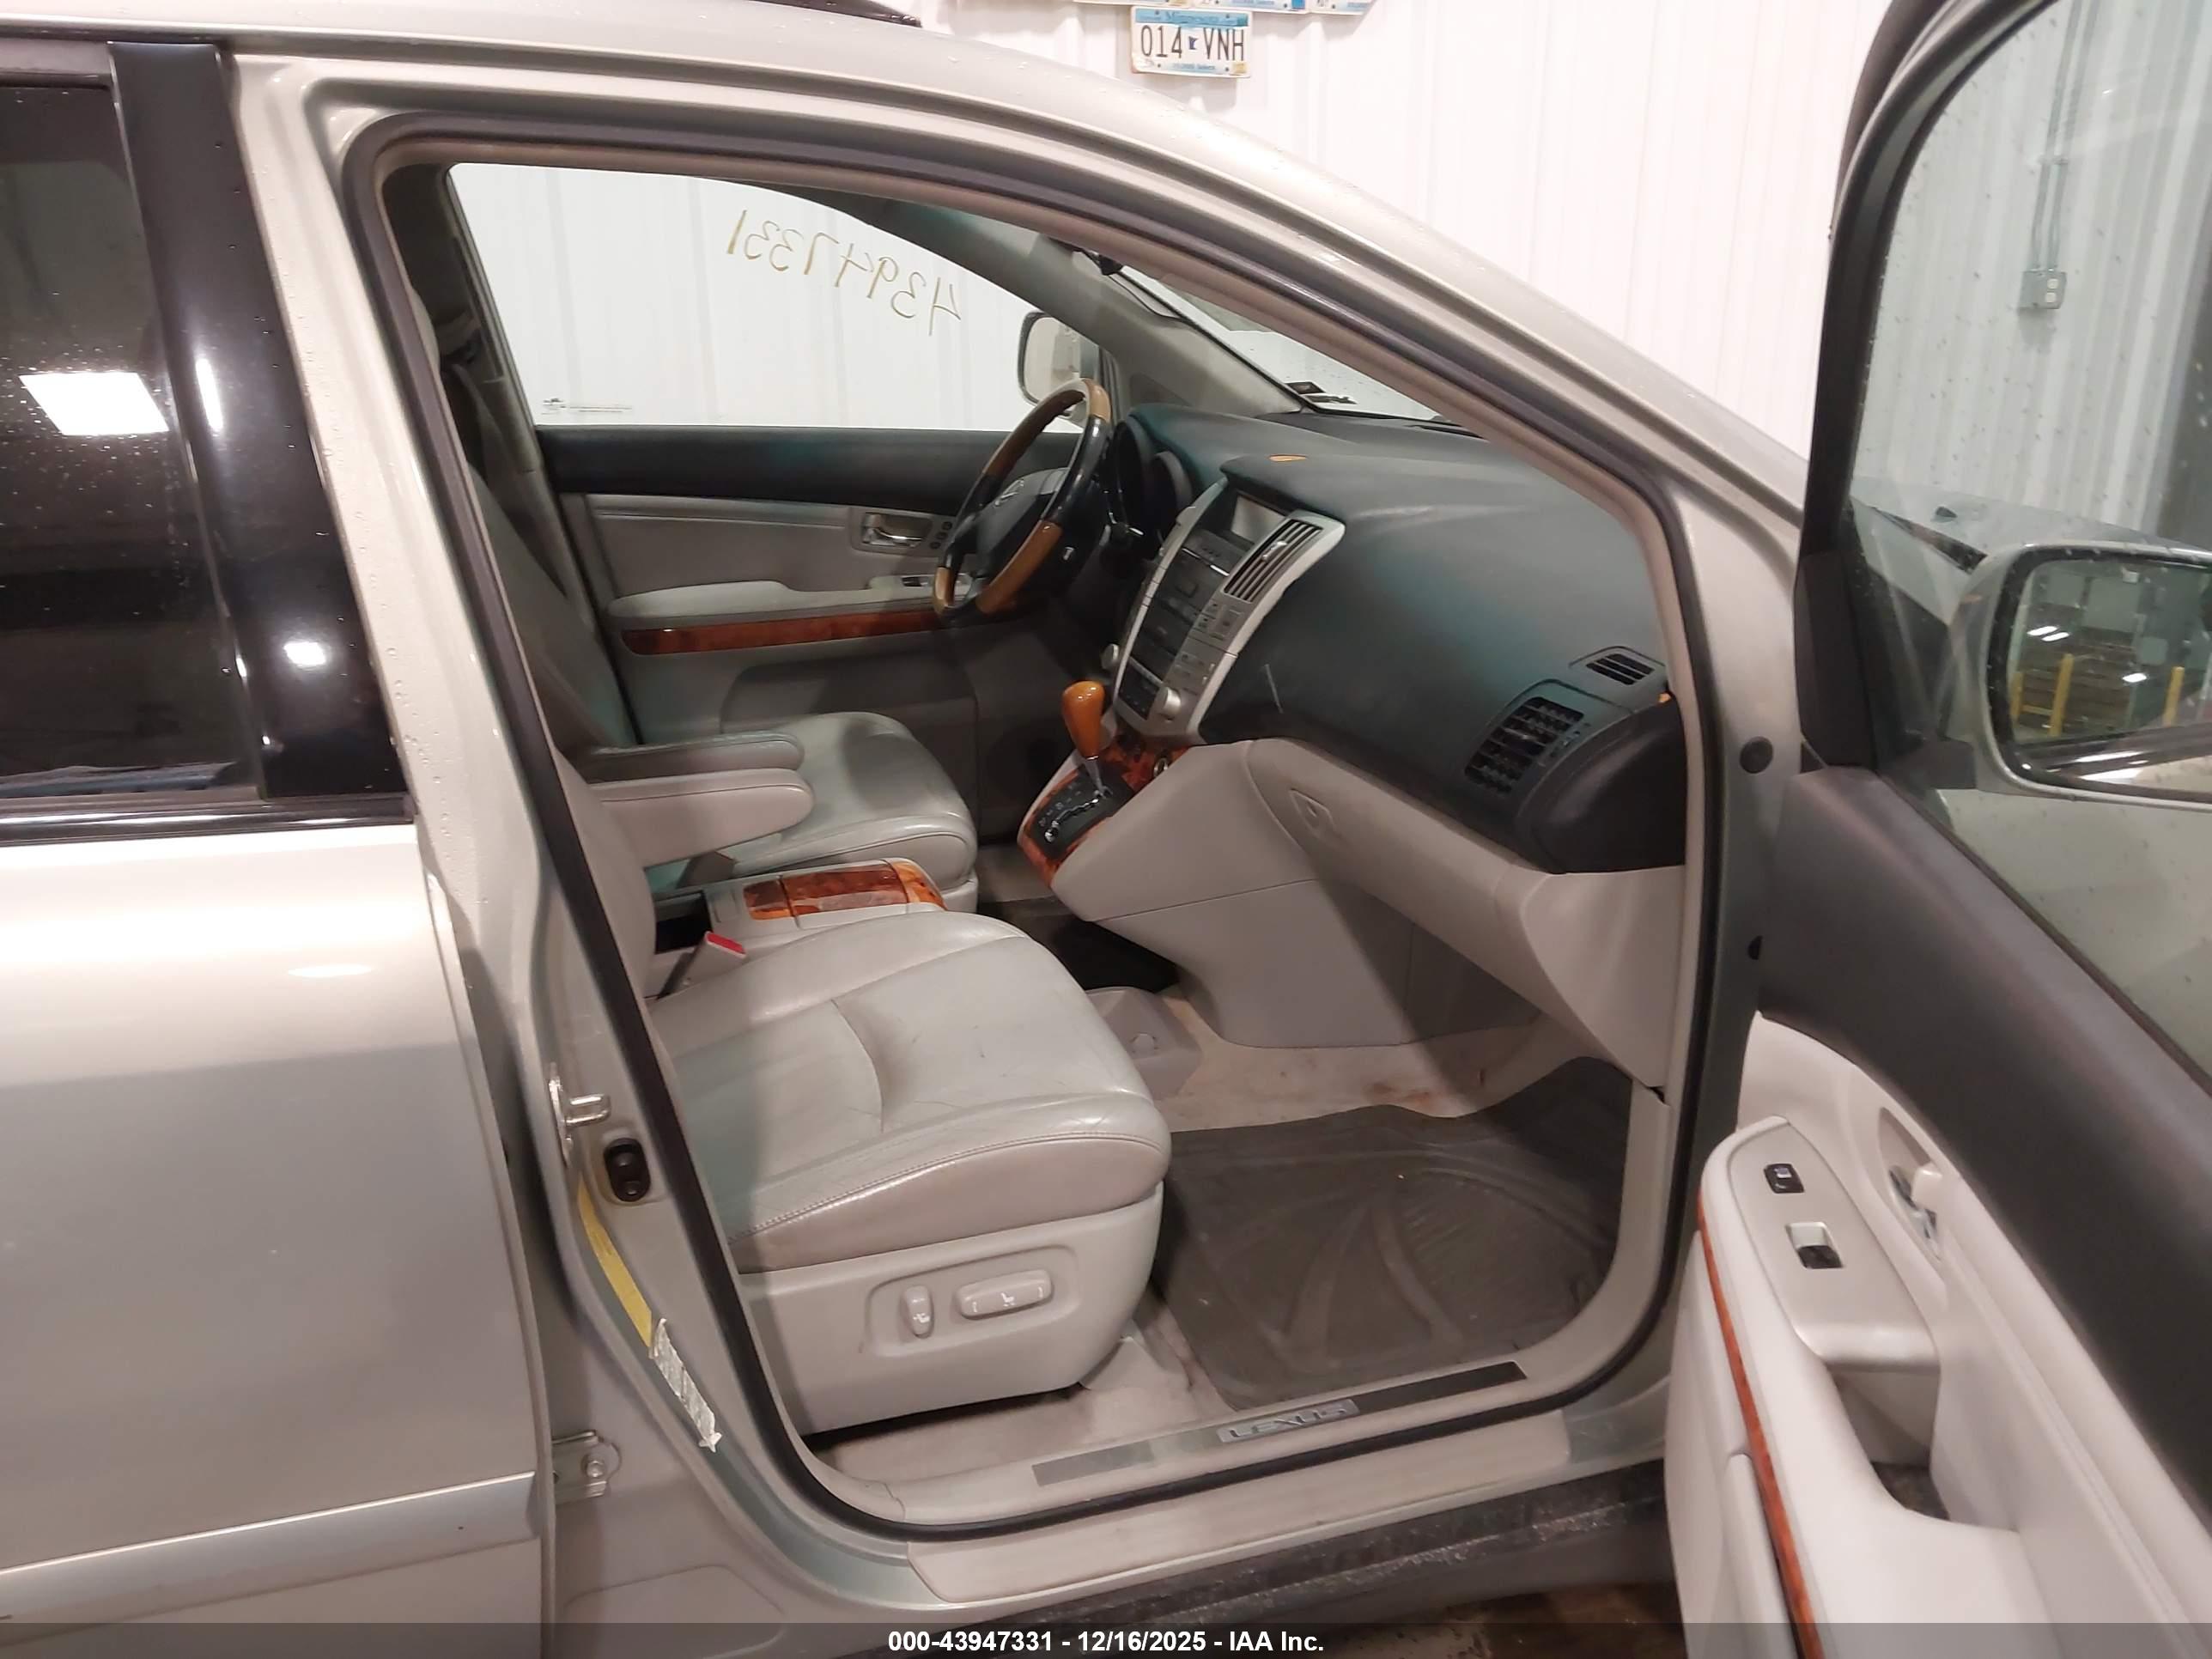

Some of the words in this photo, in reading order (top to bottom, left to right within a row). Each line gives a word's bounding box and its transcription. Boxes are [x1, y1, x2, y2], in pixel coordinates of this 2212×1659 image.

[1140, 24, 1182, 58] 014
[1203, 27, 1244, 61] VNH
[1229, 1403, 1347, 1438] LEXUS
